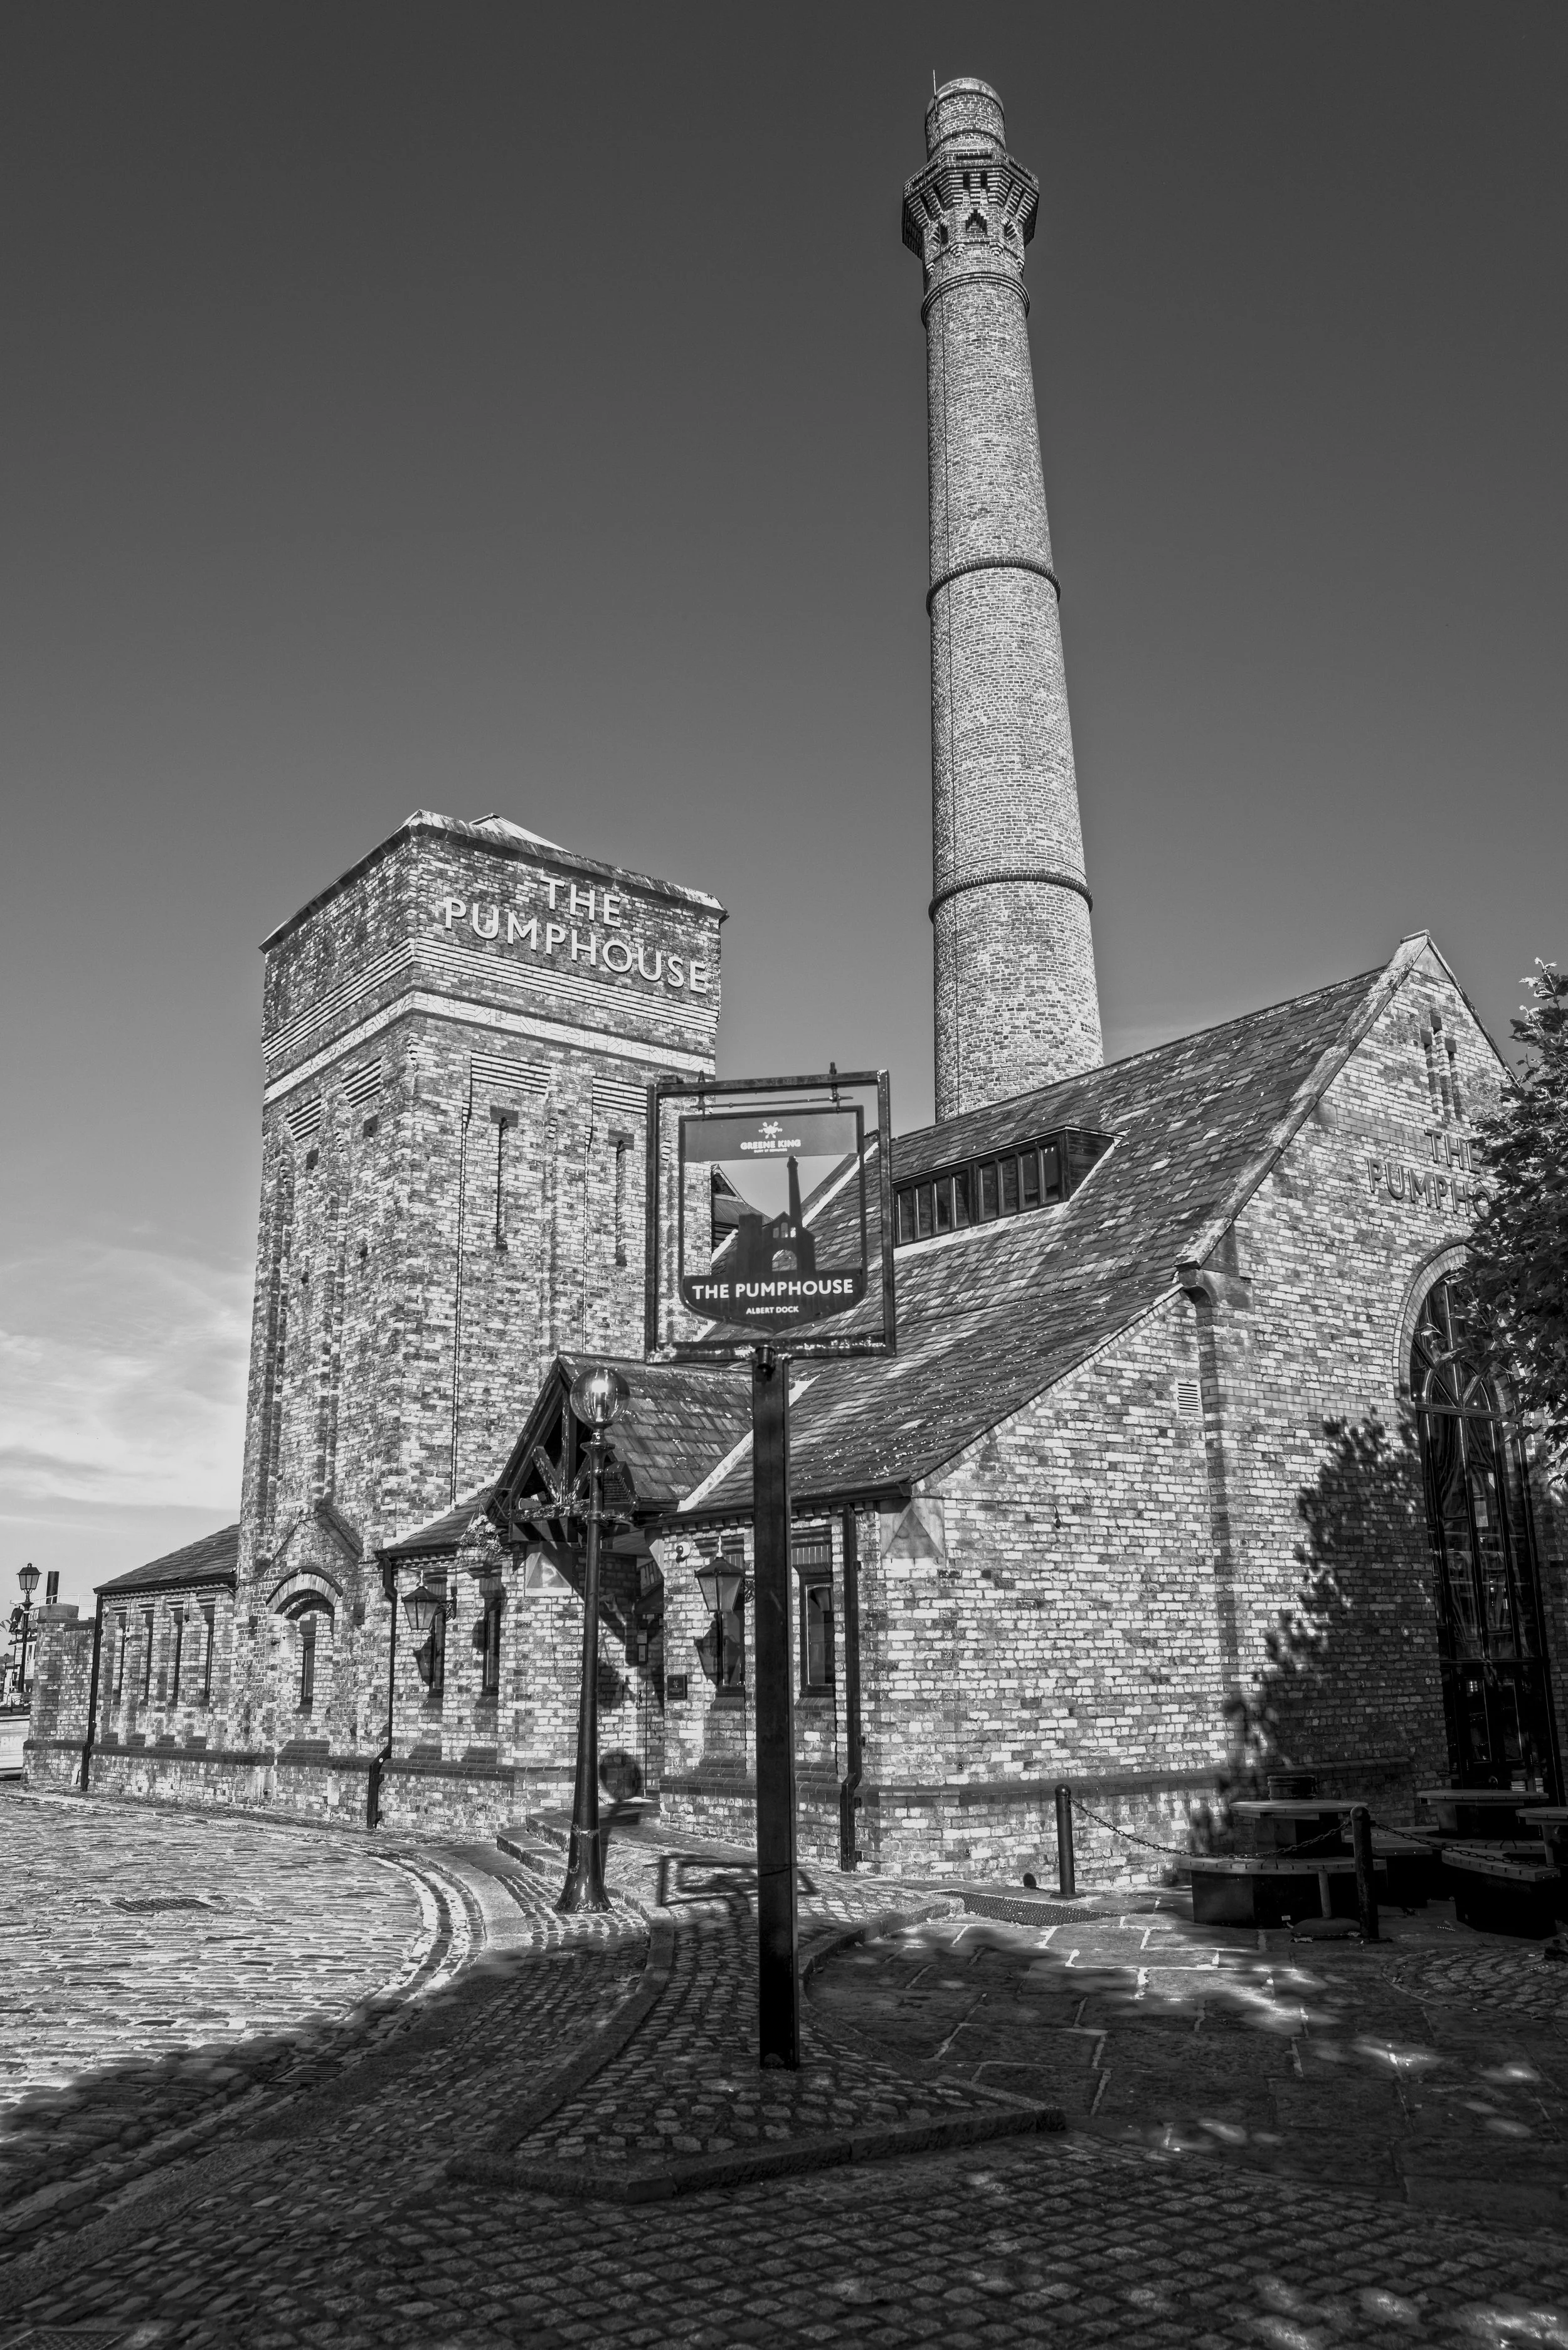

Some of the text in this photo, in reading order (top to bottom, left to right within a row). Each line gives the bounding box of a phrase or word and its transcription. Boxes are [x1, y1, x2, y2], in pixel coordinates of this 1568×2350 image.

[541, 876, 622, 928] THE
[443, 896, 707, 994] PUMPHOUSE
[740, 1139, 802, 1150] GREENE KING
[692, 1279, 854, 1300] THE PUMPHOUSE
[746, 1305, 799, 1315] ALBERT DOCK
